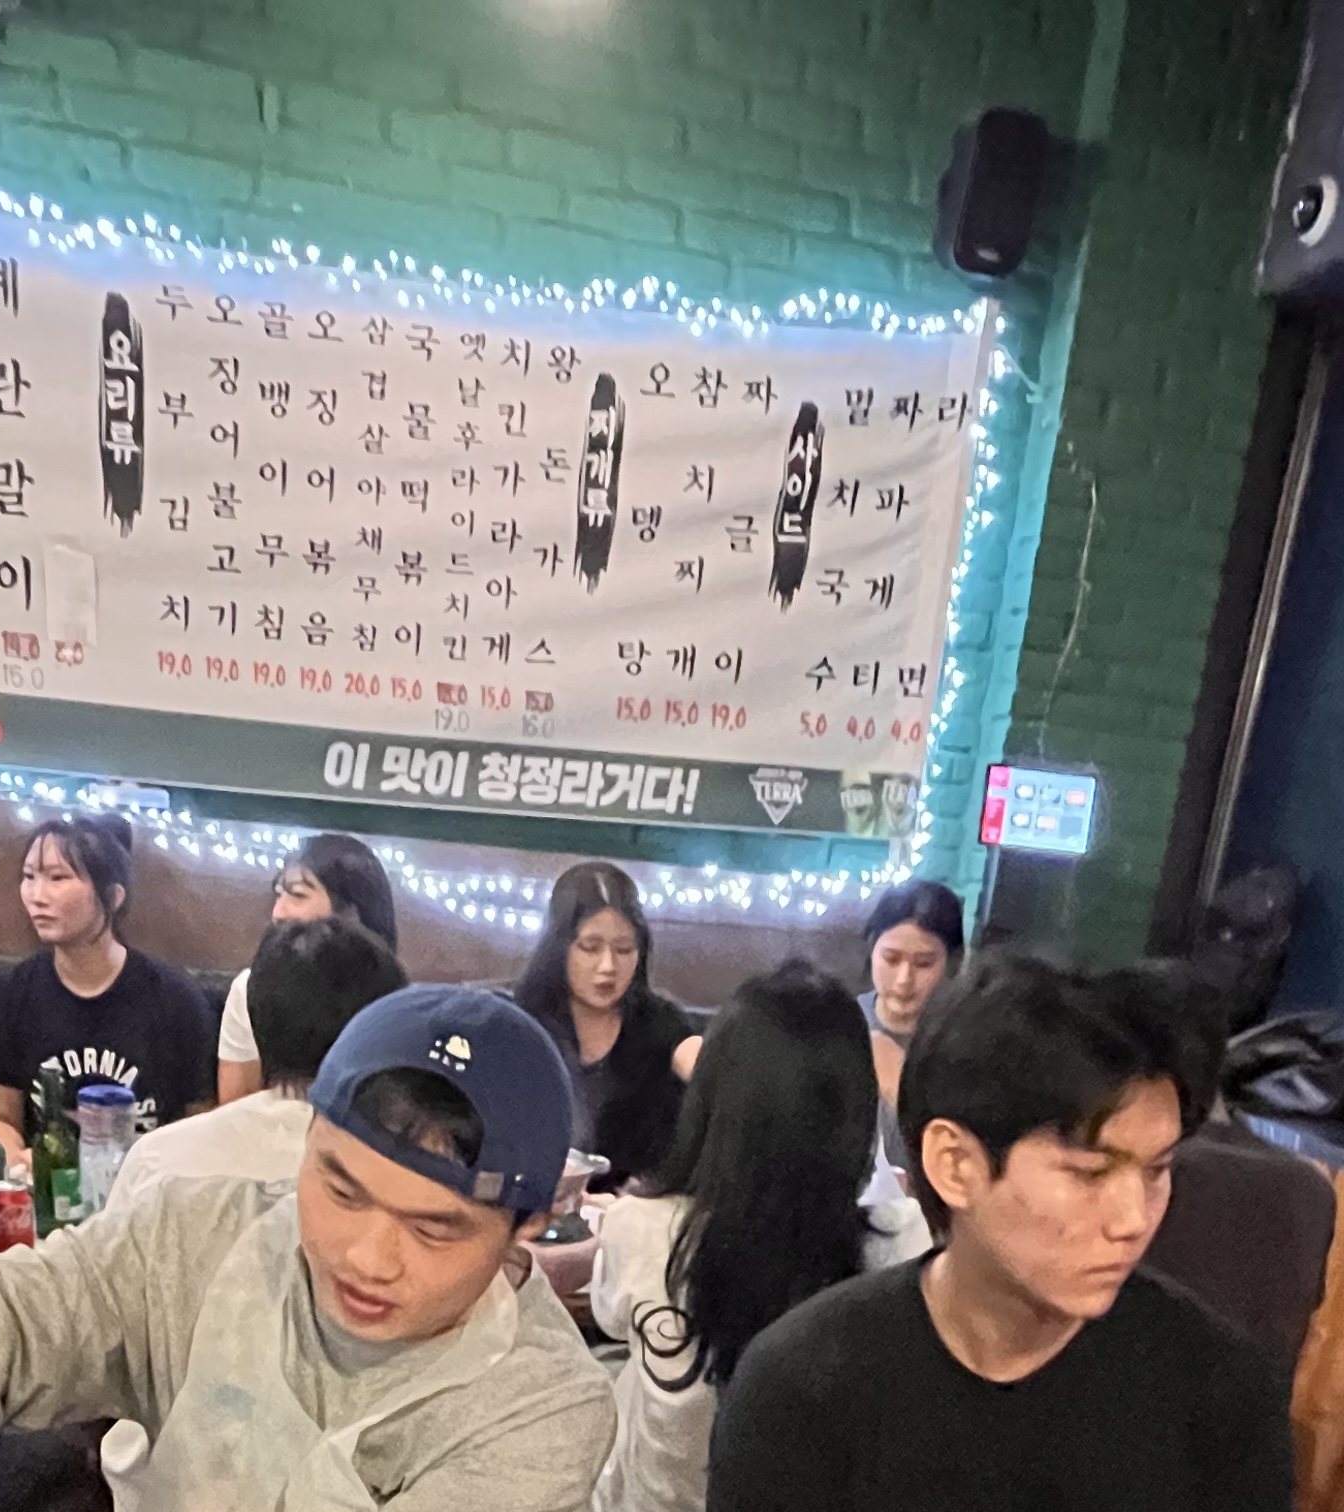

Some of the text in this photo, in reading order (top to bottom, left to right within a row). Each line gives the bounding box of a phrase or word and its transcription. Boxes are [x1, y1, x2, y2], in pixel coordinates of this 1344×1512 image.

[105, 330, 142, 464] 요리류
[156, 284, 194, 632] 두부김치
[207, 294, 244, 636] 오징어불고기
[254, 301, 294, 641] 골뱅이무침
[300, 310, 344, 647] 오징어볶음
[524, 345, 582, 665] 왕돈가스
[580, 405, 615, 527] 찌개류
[776, 431, 818, 543] 사이드
[158, 651, 192, 680] 19.0
[206, 656, 240, 683] 19.0
[253, 661, 287, 688] 19.0
[300, 666, 333, 694] 19.0
[344, 671, 380, 698] 20.0
[390, 676, 423, 703] 15.0
[480, 685, 512, 711] 15.0
[616, 697, 651, 723] 15.0
[664, 700, 699, 727] 15.0
[711, 703, 747, 731] 19.0
[324, 741, 701, 816] 이 맛이 청정라거다!
